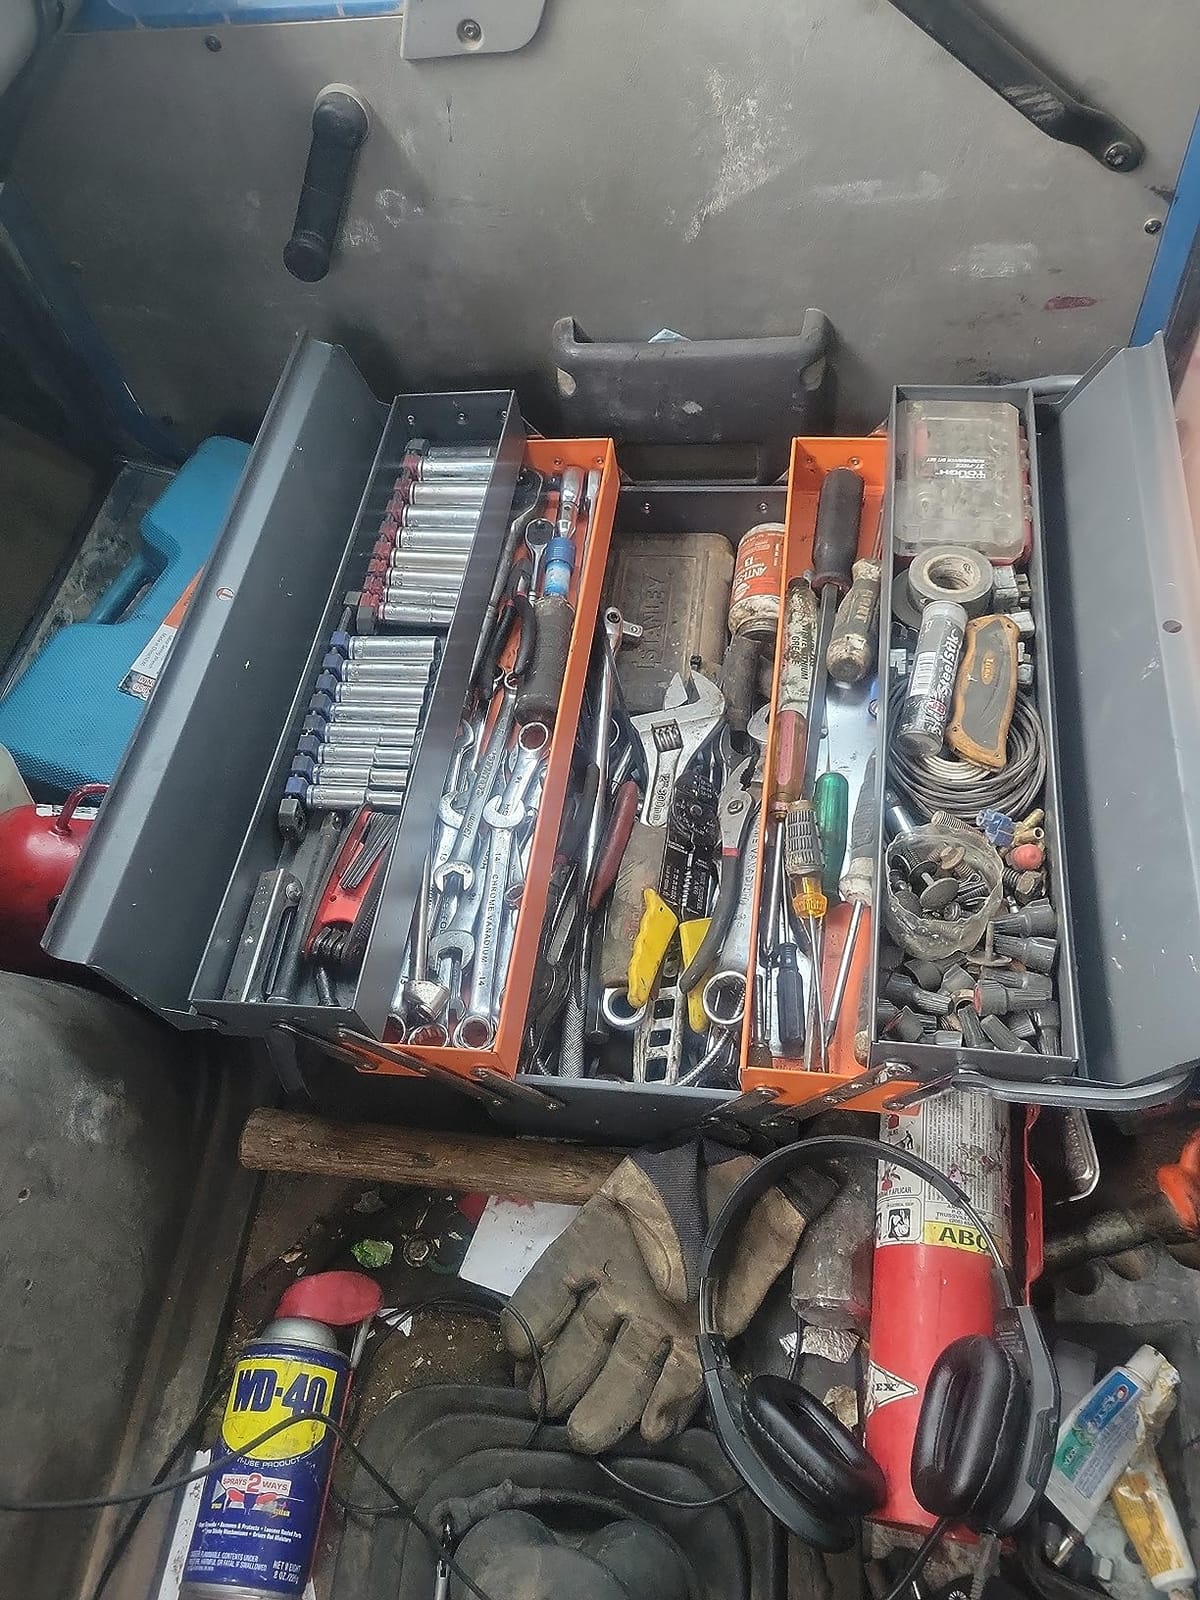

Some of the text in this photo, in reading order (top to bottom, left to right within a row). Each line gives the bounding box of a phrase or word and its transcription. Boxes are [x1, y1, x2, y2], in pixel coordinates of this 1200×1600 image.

[638, 574, 665, 661] STANLEY
[488, 874, 499, 912] CHROME
[481, 915, 493, 964] VANADIUM
[478, 976, 486, 987] 14
[232, 1368, 328, 1417] WD-40
[262, 1457, 301, 1468] PRODUCT
[223, 1473, 288, 1492] SPRAYS 2 WAYS
[272, 1560, 285, 1569] NET
